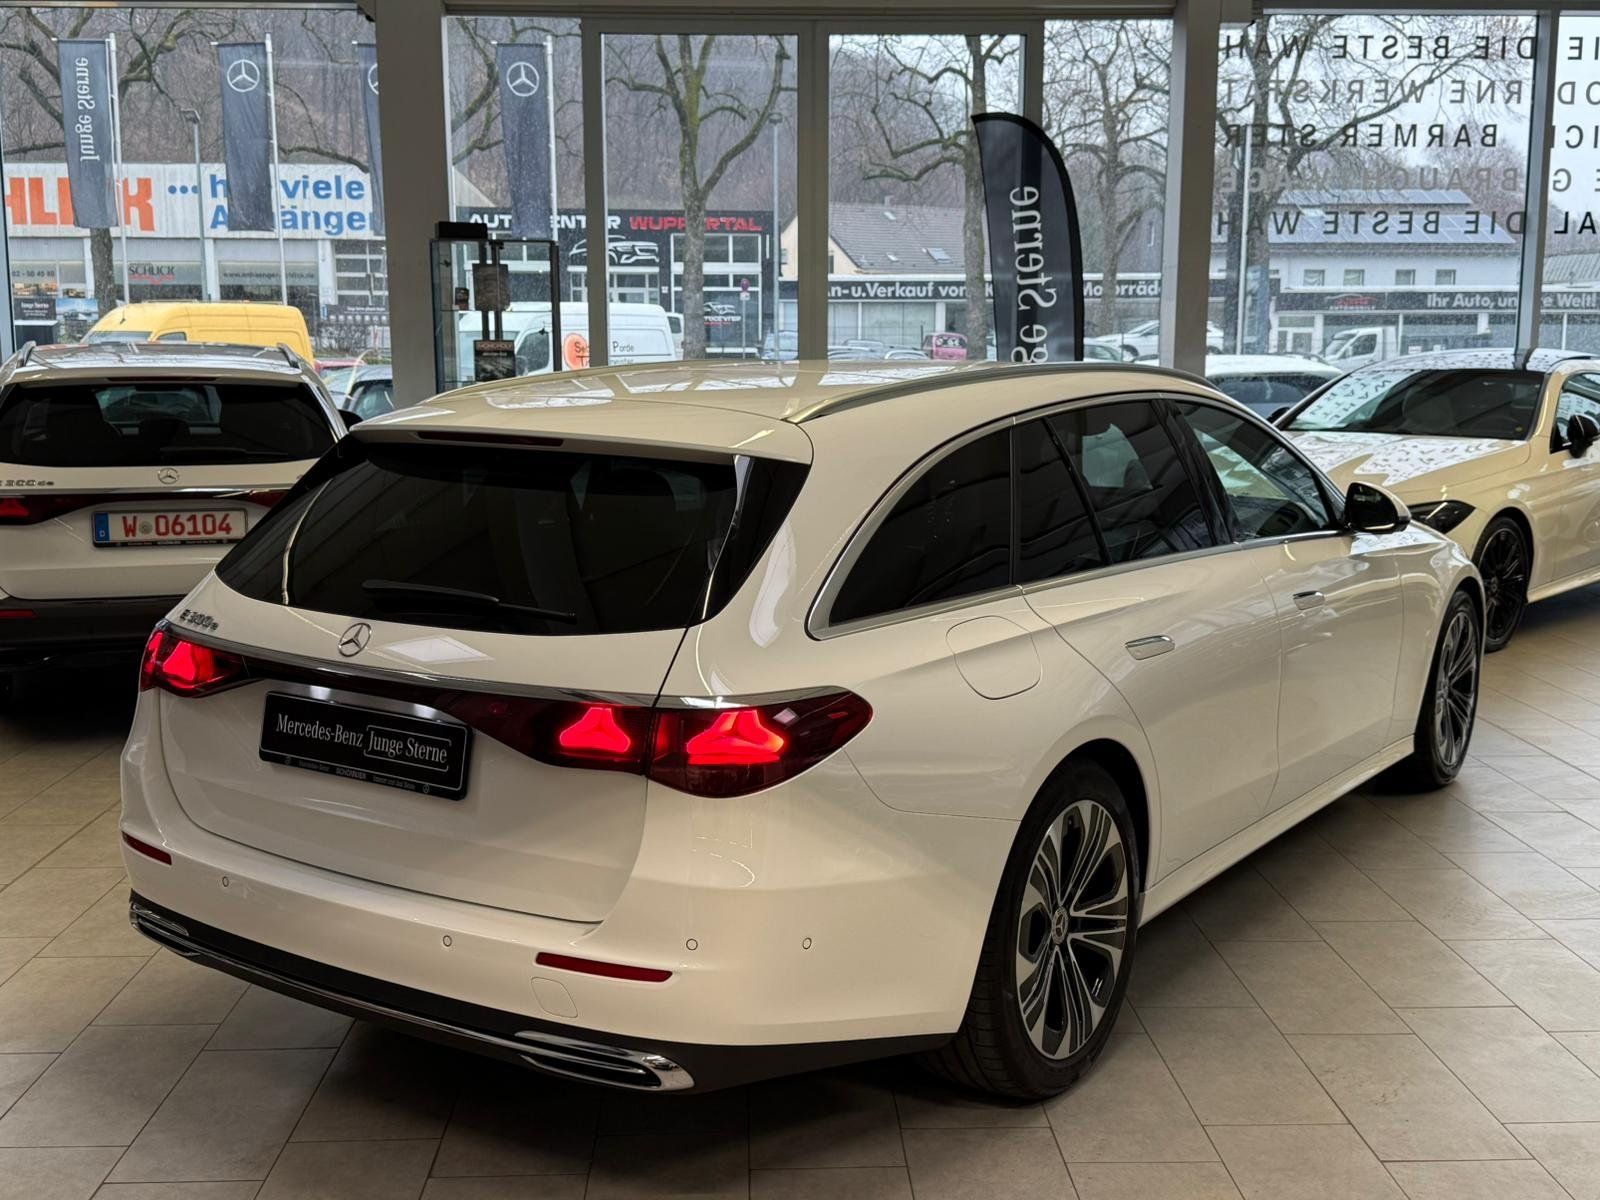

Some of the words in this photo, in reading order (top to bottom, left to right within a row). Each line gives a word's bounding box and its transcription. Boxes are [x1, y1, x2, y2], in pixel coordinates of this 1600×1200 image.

[279, 174, 365, 200] viele
[209, 204, 374, 236] Aänge
[469, 213, 513, 229] AUT
[629, 215, 763, 231] WUPPRTAL
[828, 282, 935, 298] n-u.Verkauf
[1427, 293, 1449, 308] Ihr
[1452, 293, 1495, 310] Auto,
[1556, 293, 1597, 309] Welt!
[122, 515, 138, 538] W
[154, 512, 233, 537] 06104
[275, 712, 364, 749] Mercedes-Benz
[367, 730, 404, 759] Junge
[405, 736, 448, 764] Sterne
